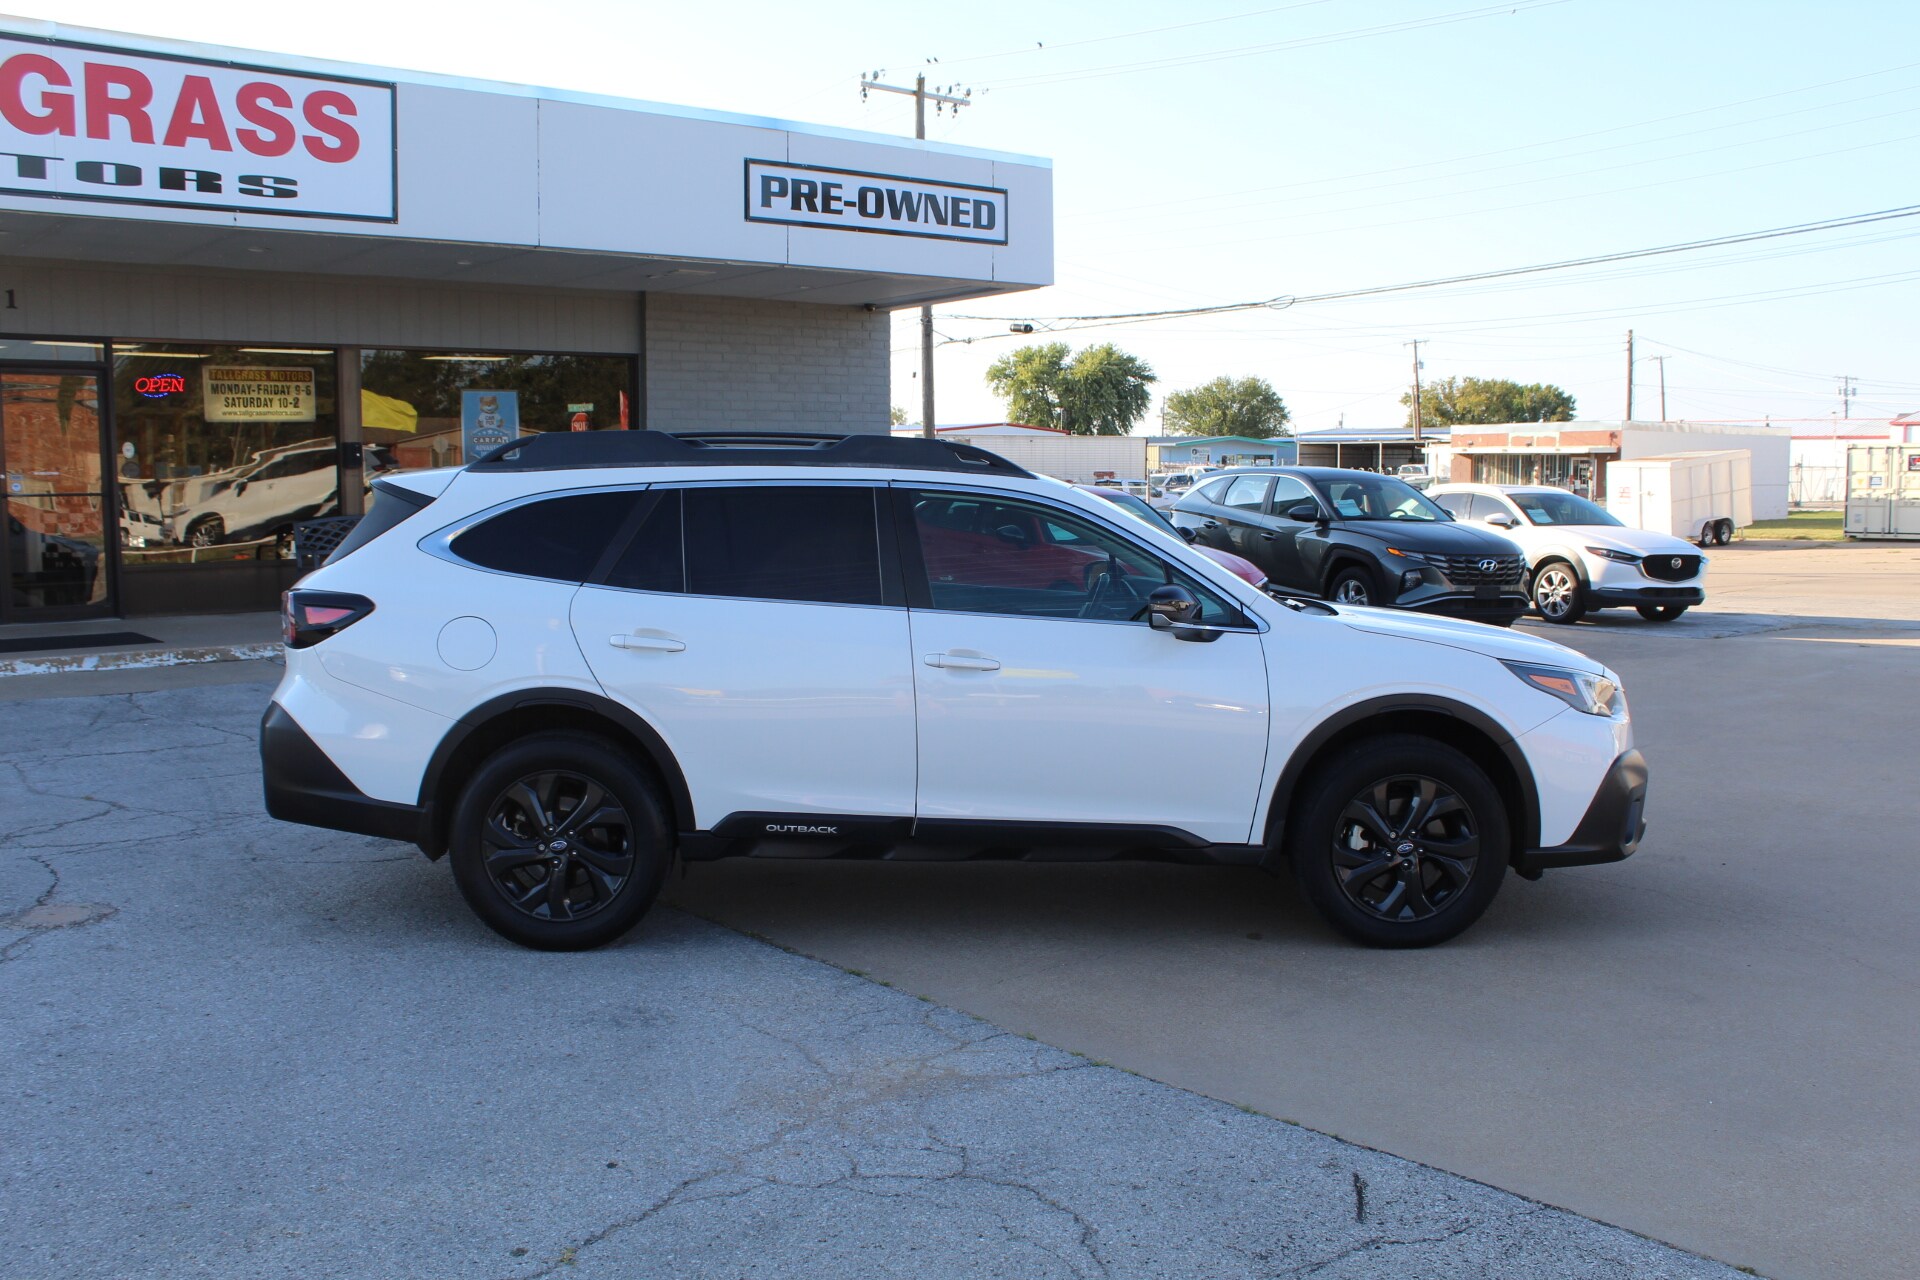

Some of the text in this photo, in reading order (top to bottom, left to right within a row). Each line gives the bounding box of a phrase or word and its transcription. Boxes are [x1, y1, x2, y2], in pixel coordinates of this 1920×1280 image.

[0, 53, 360, 163] GRASS
[760, 174, 996, 230] PRE-OWNED
[210, 370, 310, 381] TALLGRASS MOTORS
[135, 377, 184, 392] OPEN
[210, 383, 291, 395] MONDAY-FRIDAY
[224, 396, 300, 408] SATURDAY 10-2
[765, 824, 838, 834] OUTBACK
